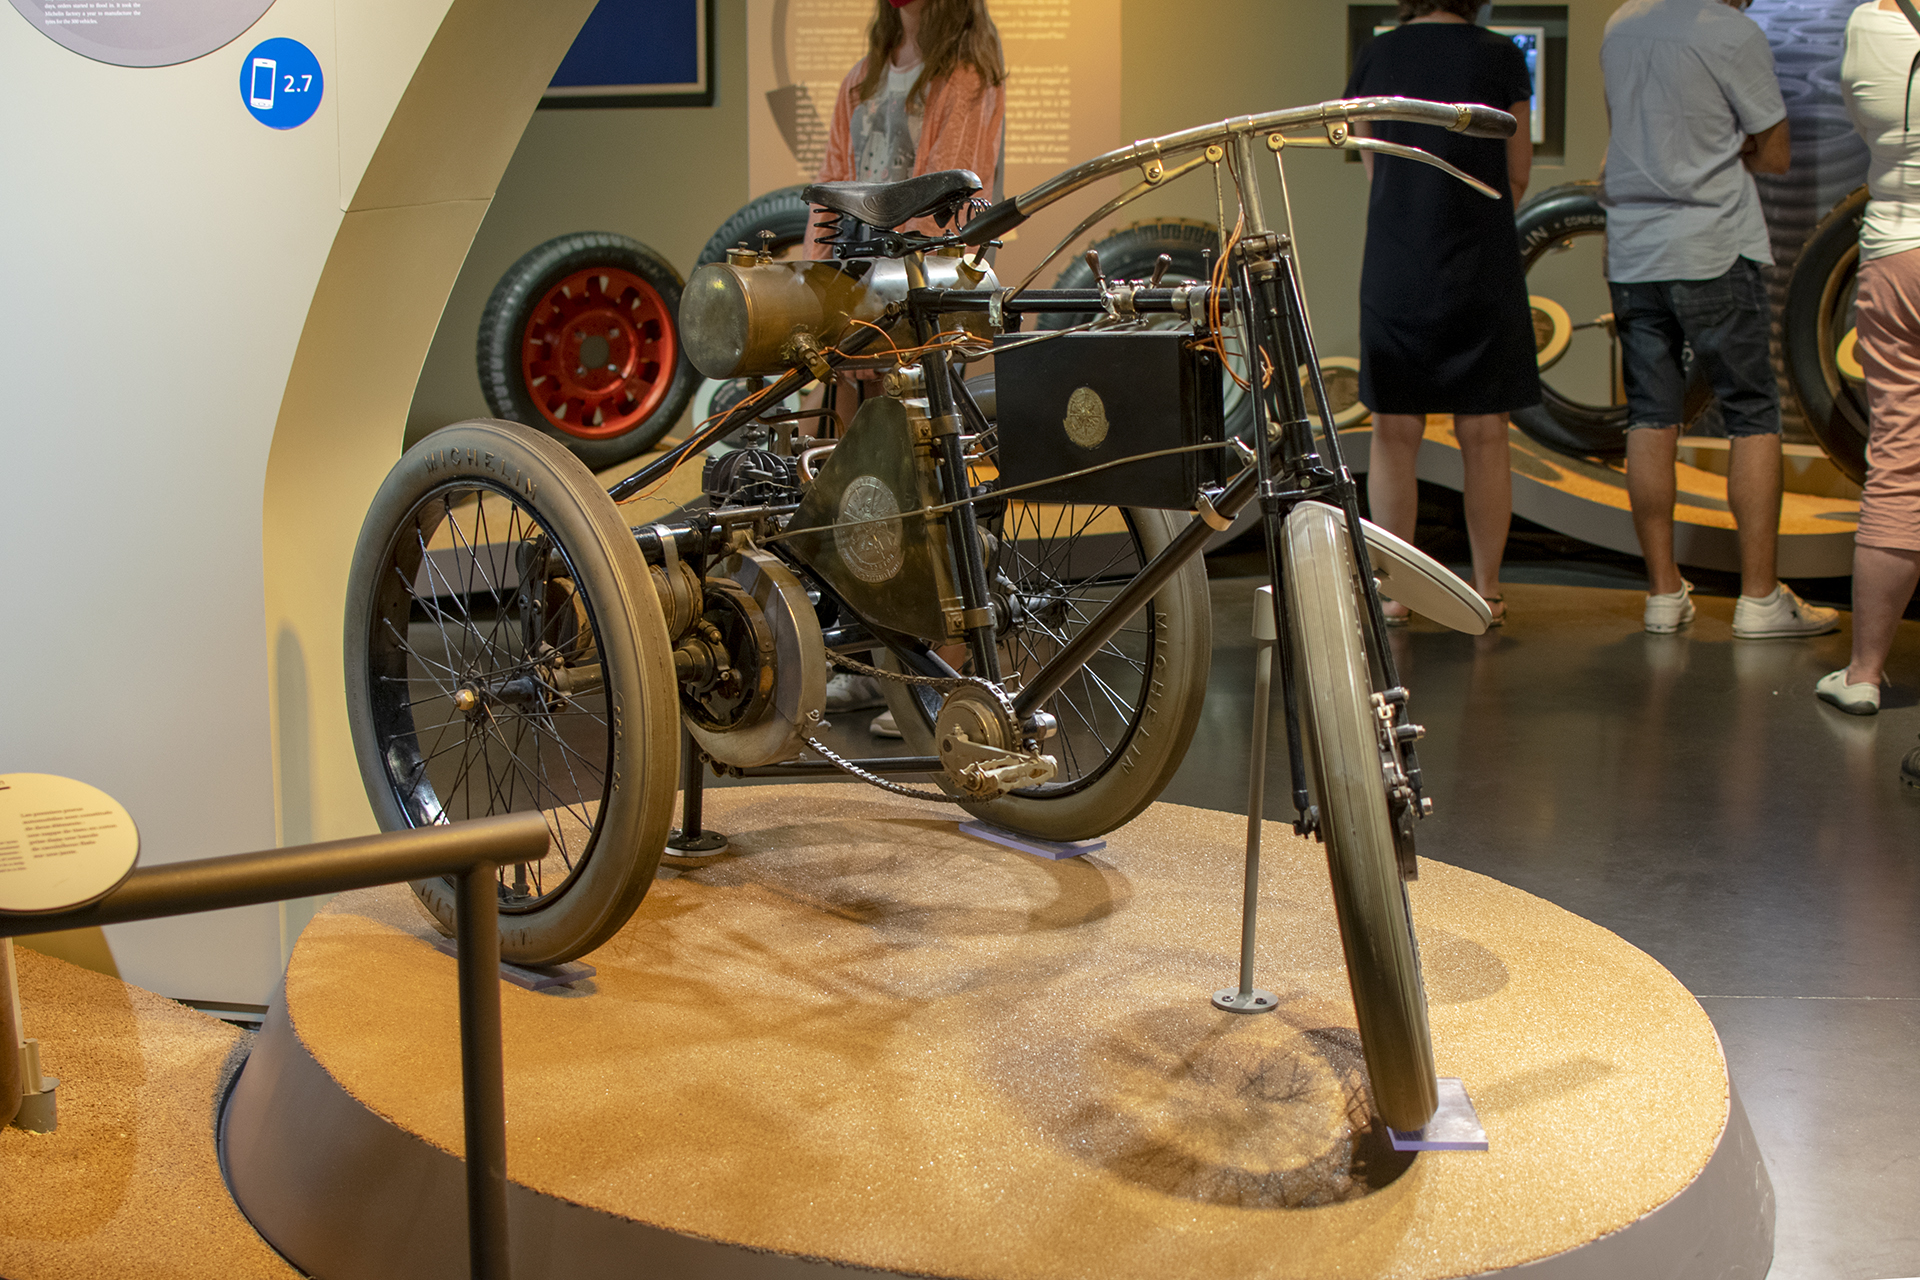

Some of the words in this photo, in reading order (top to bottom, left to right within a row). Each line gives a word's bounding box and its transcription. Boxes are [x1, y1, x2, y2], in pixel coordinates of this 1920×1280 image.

[284, 75, 312, 92] 2.7
[424, 447, 537, 500] MICHELIN
[1121, 612, 1168, 775] MICHELIN
